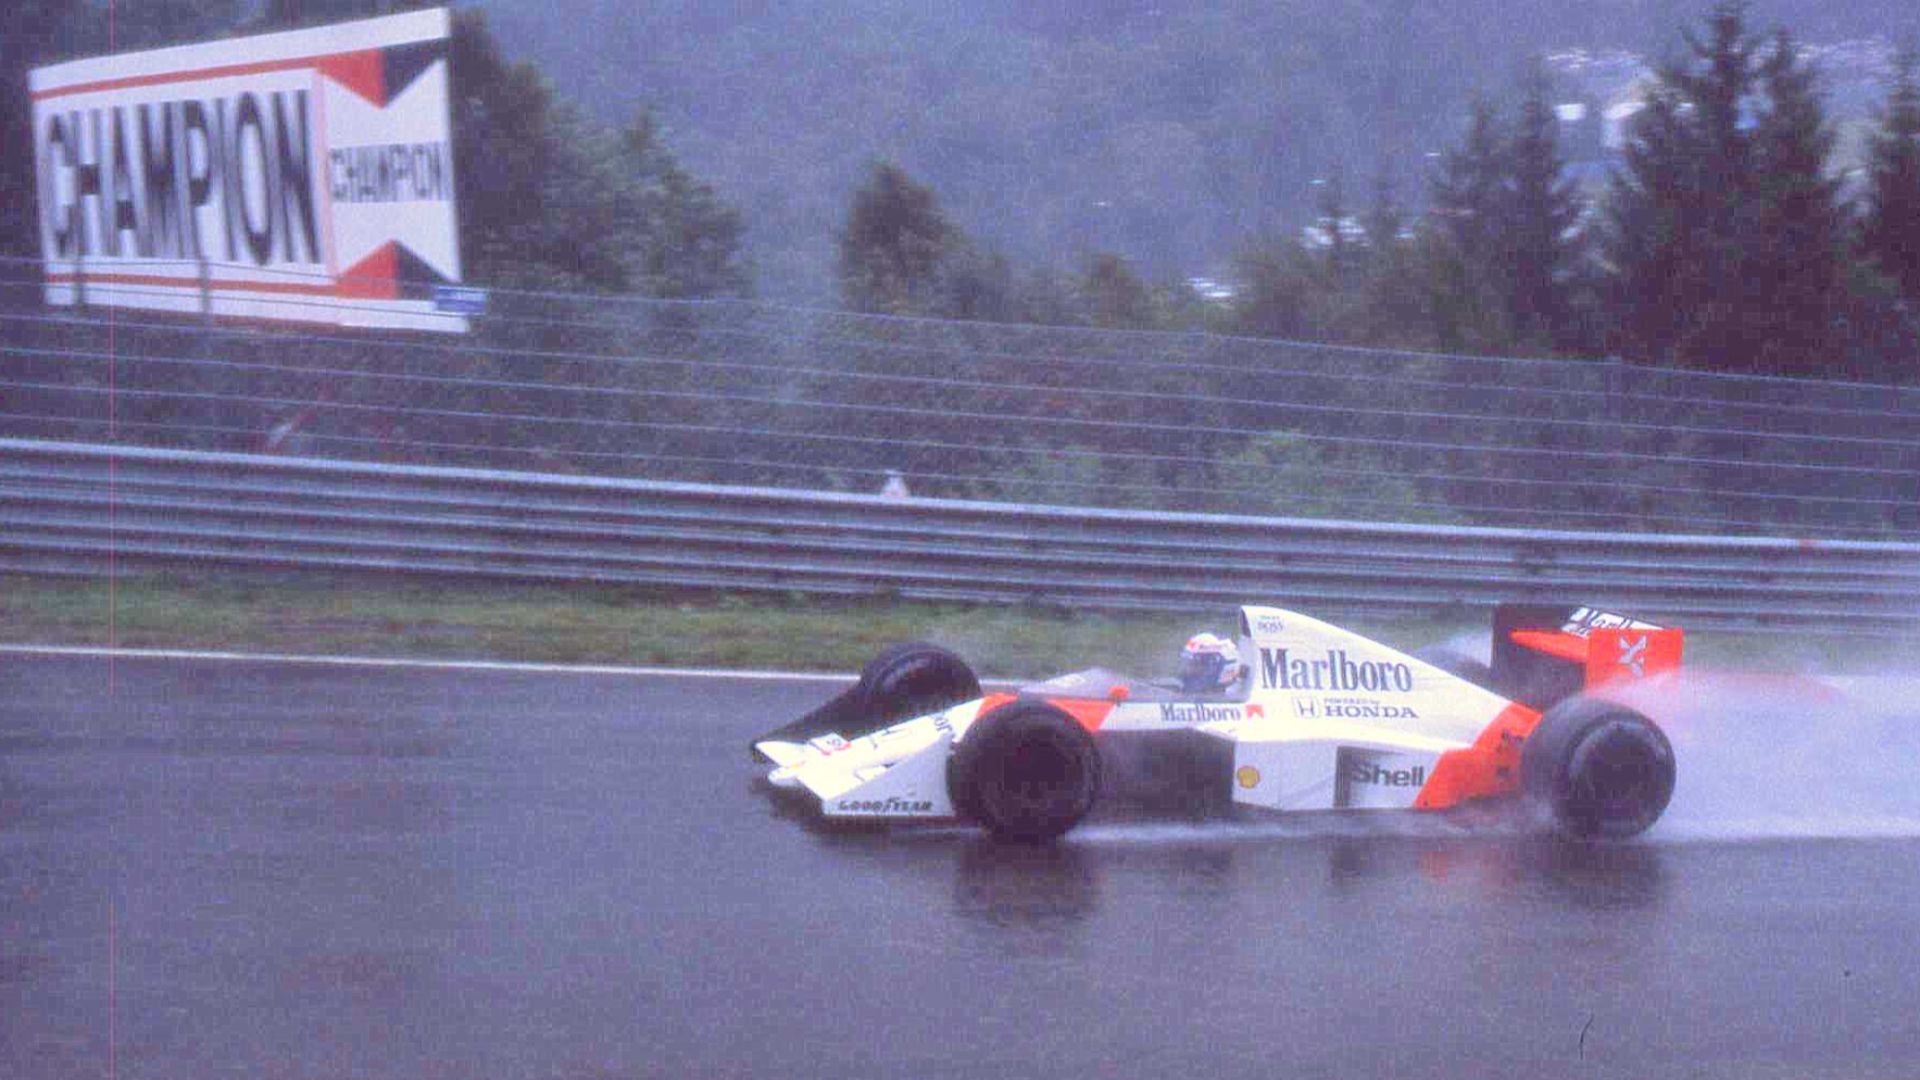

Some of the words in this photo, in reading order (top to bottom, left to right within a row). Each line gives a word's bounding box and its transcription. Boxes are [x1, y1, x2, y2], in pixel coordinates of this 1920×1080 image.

[45, 89, 323, 266] CHAMPION
[329, 141, 449, 203] CHAMPION
[1260, 648, 1412, 692] Marlboro
[1160, 703, 1241, 721] Marlboro
[1324, 705, 1419, 718] HONDA
[1352, 764, 1424, 787] Shell
